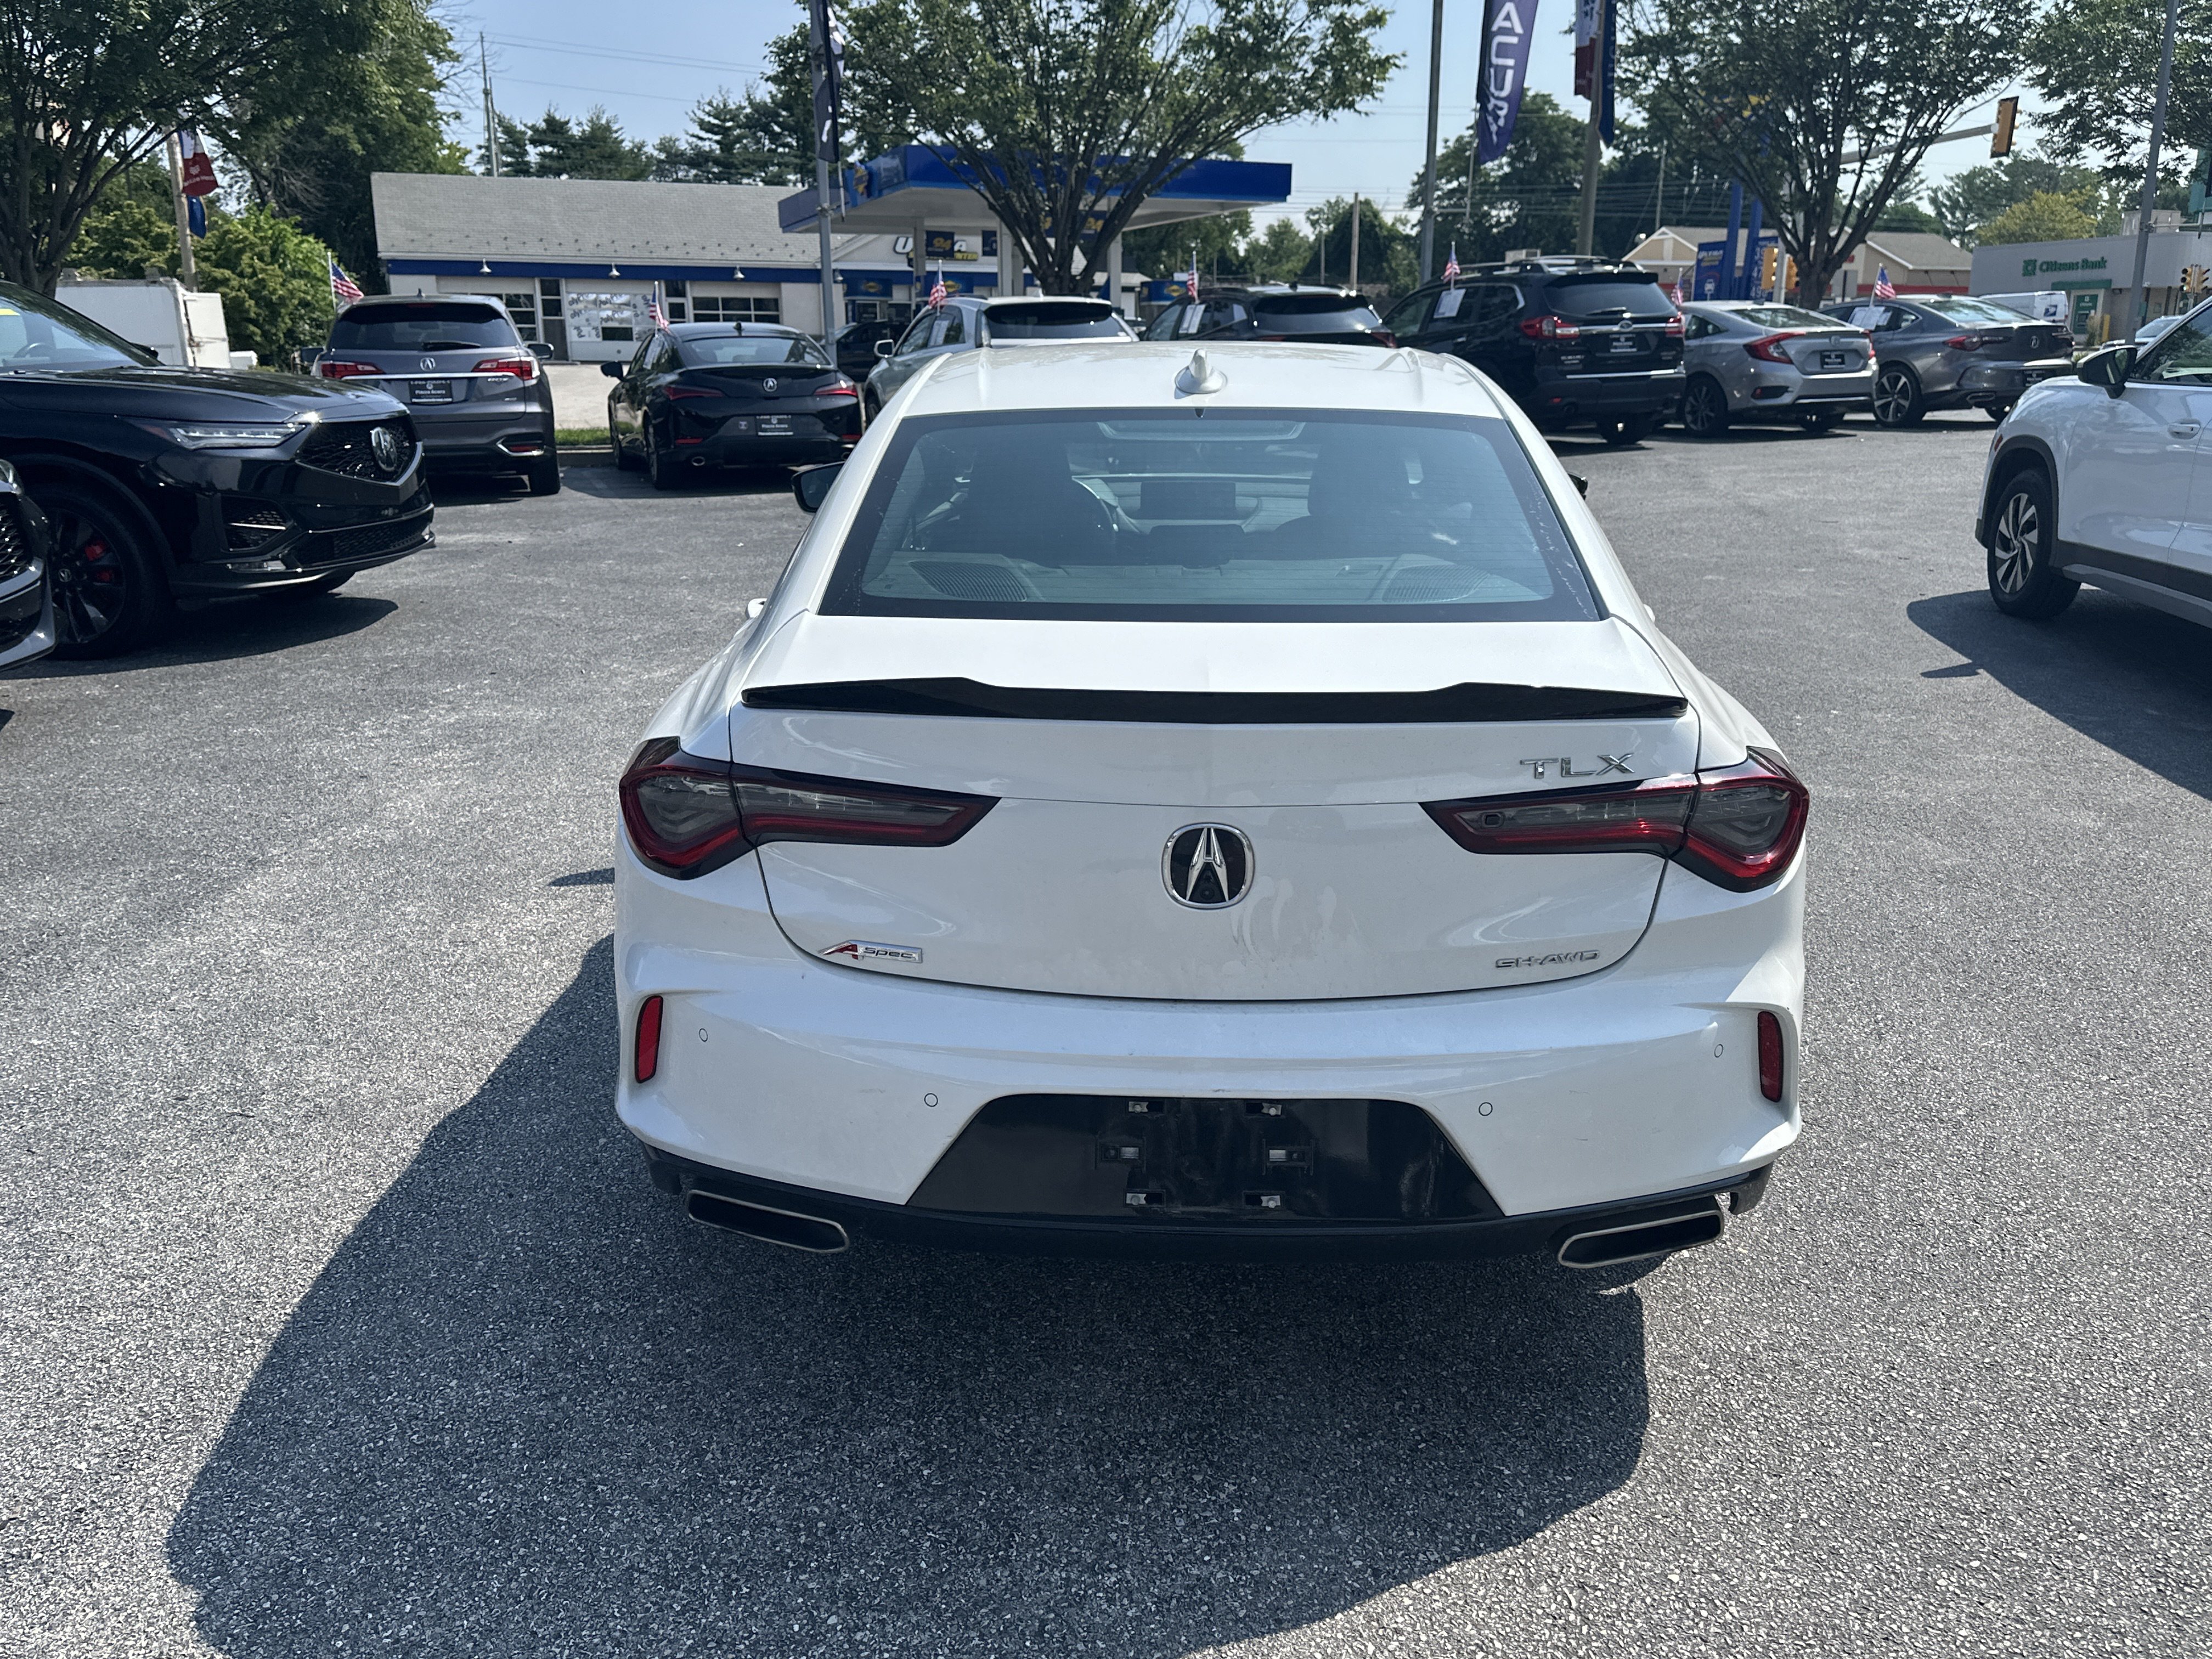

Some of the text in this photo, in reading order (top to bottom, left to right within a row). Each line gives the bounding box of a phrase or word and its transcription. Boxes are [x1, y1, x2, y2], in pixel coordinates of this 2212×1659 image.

[2039, 256, 2107, 272] Citizens Bank
[1520, 753, 1635, 779] TLX
[1496, 950, 1600, 969] SH-AWD
